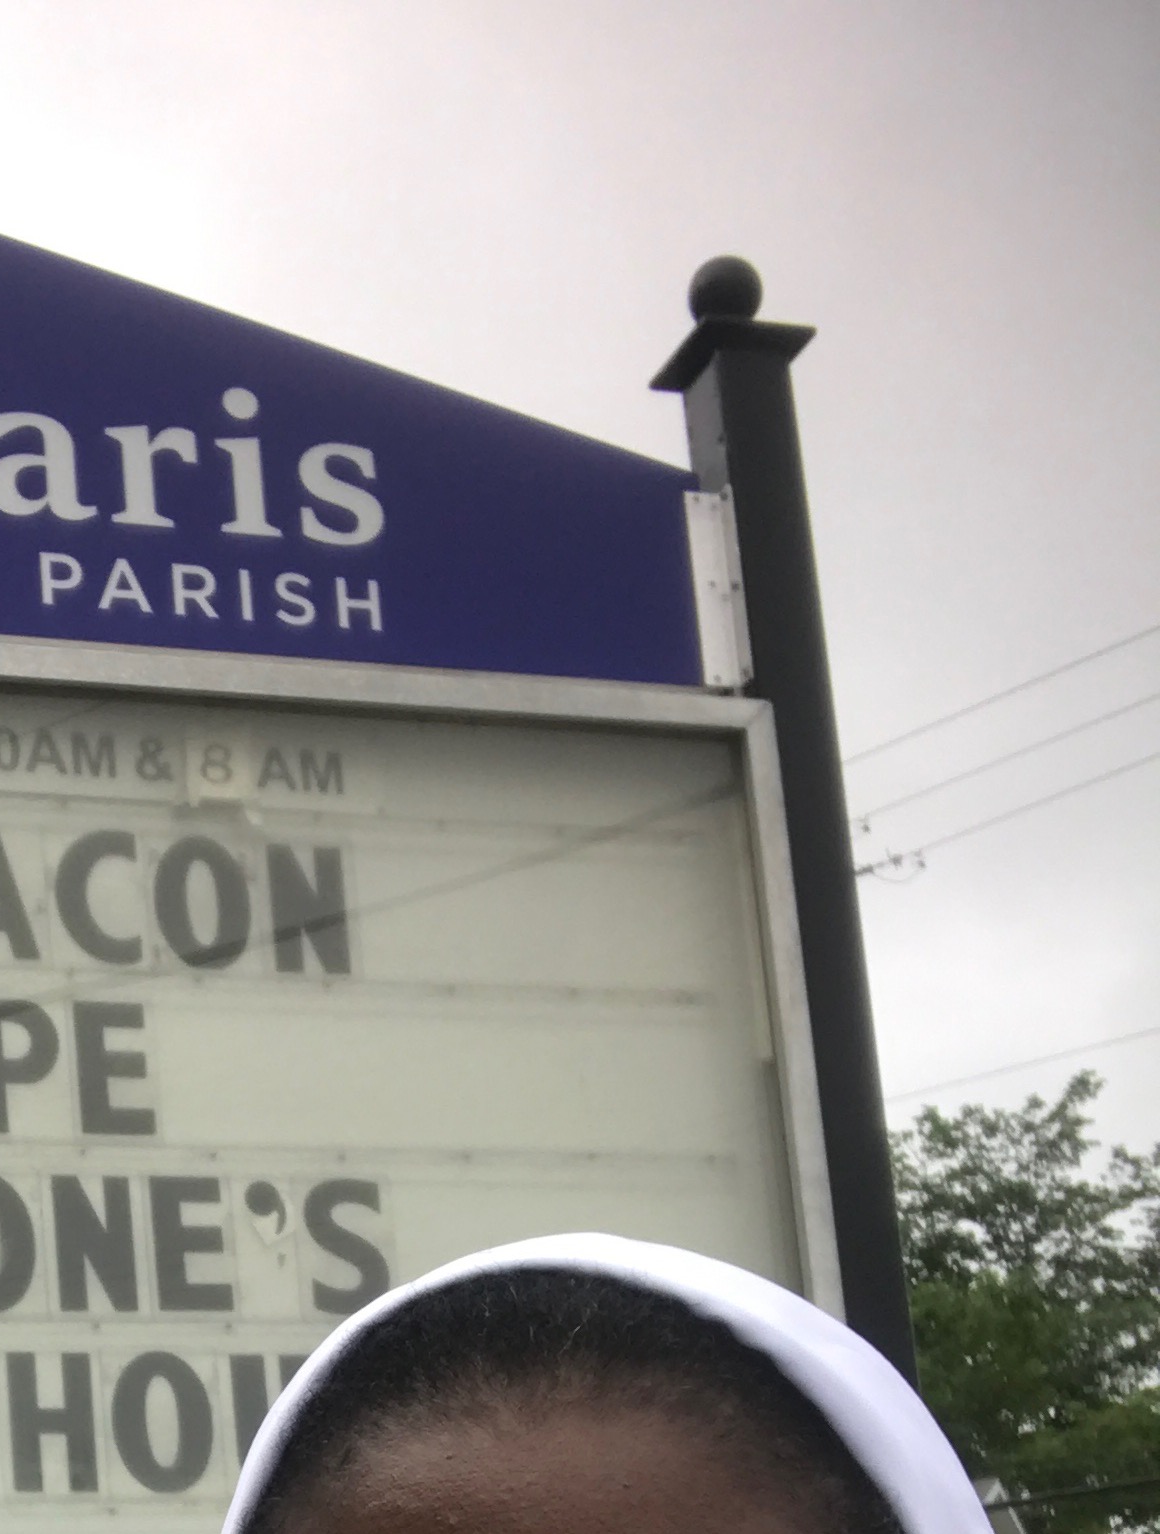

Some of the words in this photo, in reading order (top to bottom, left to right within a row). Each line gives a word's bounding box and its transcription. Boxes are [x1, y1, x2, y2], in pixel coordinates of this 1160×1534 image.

[41, 551, 384, 633] PARISH
[135, 736, 175, 783] &
[198, 742, 234, 785] 8
[255, 746, 345, 796] AM
